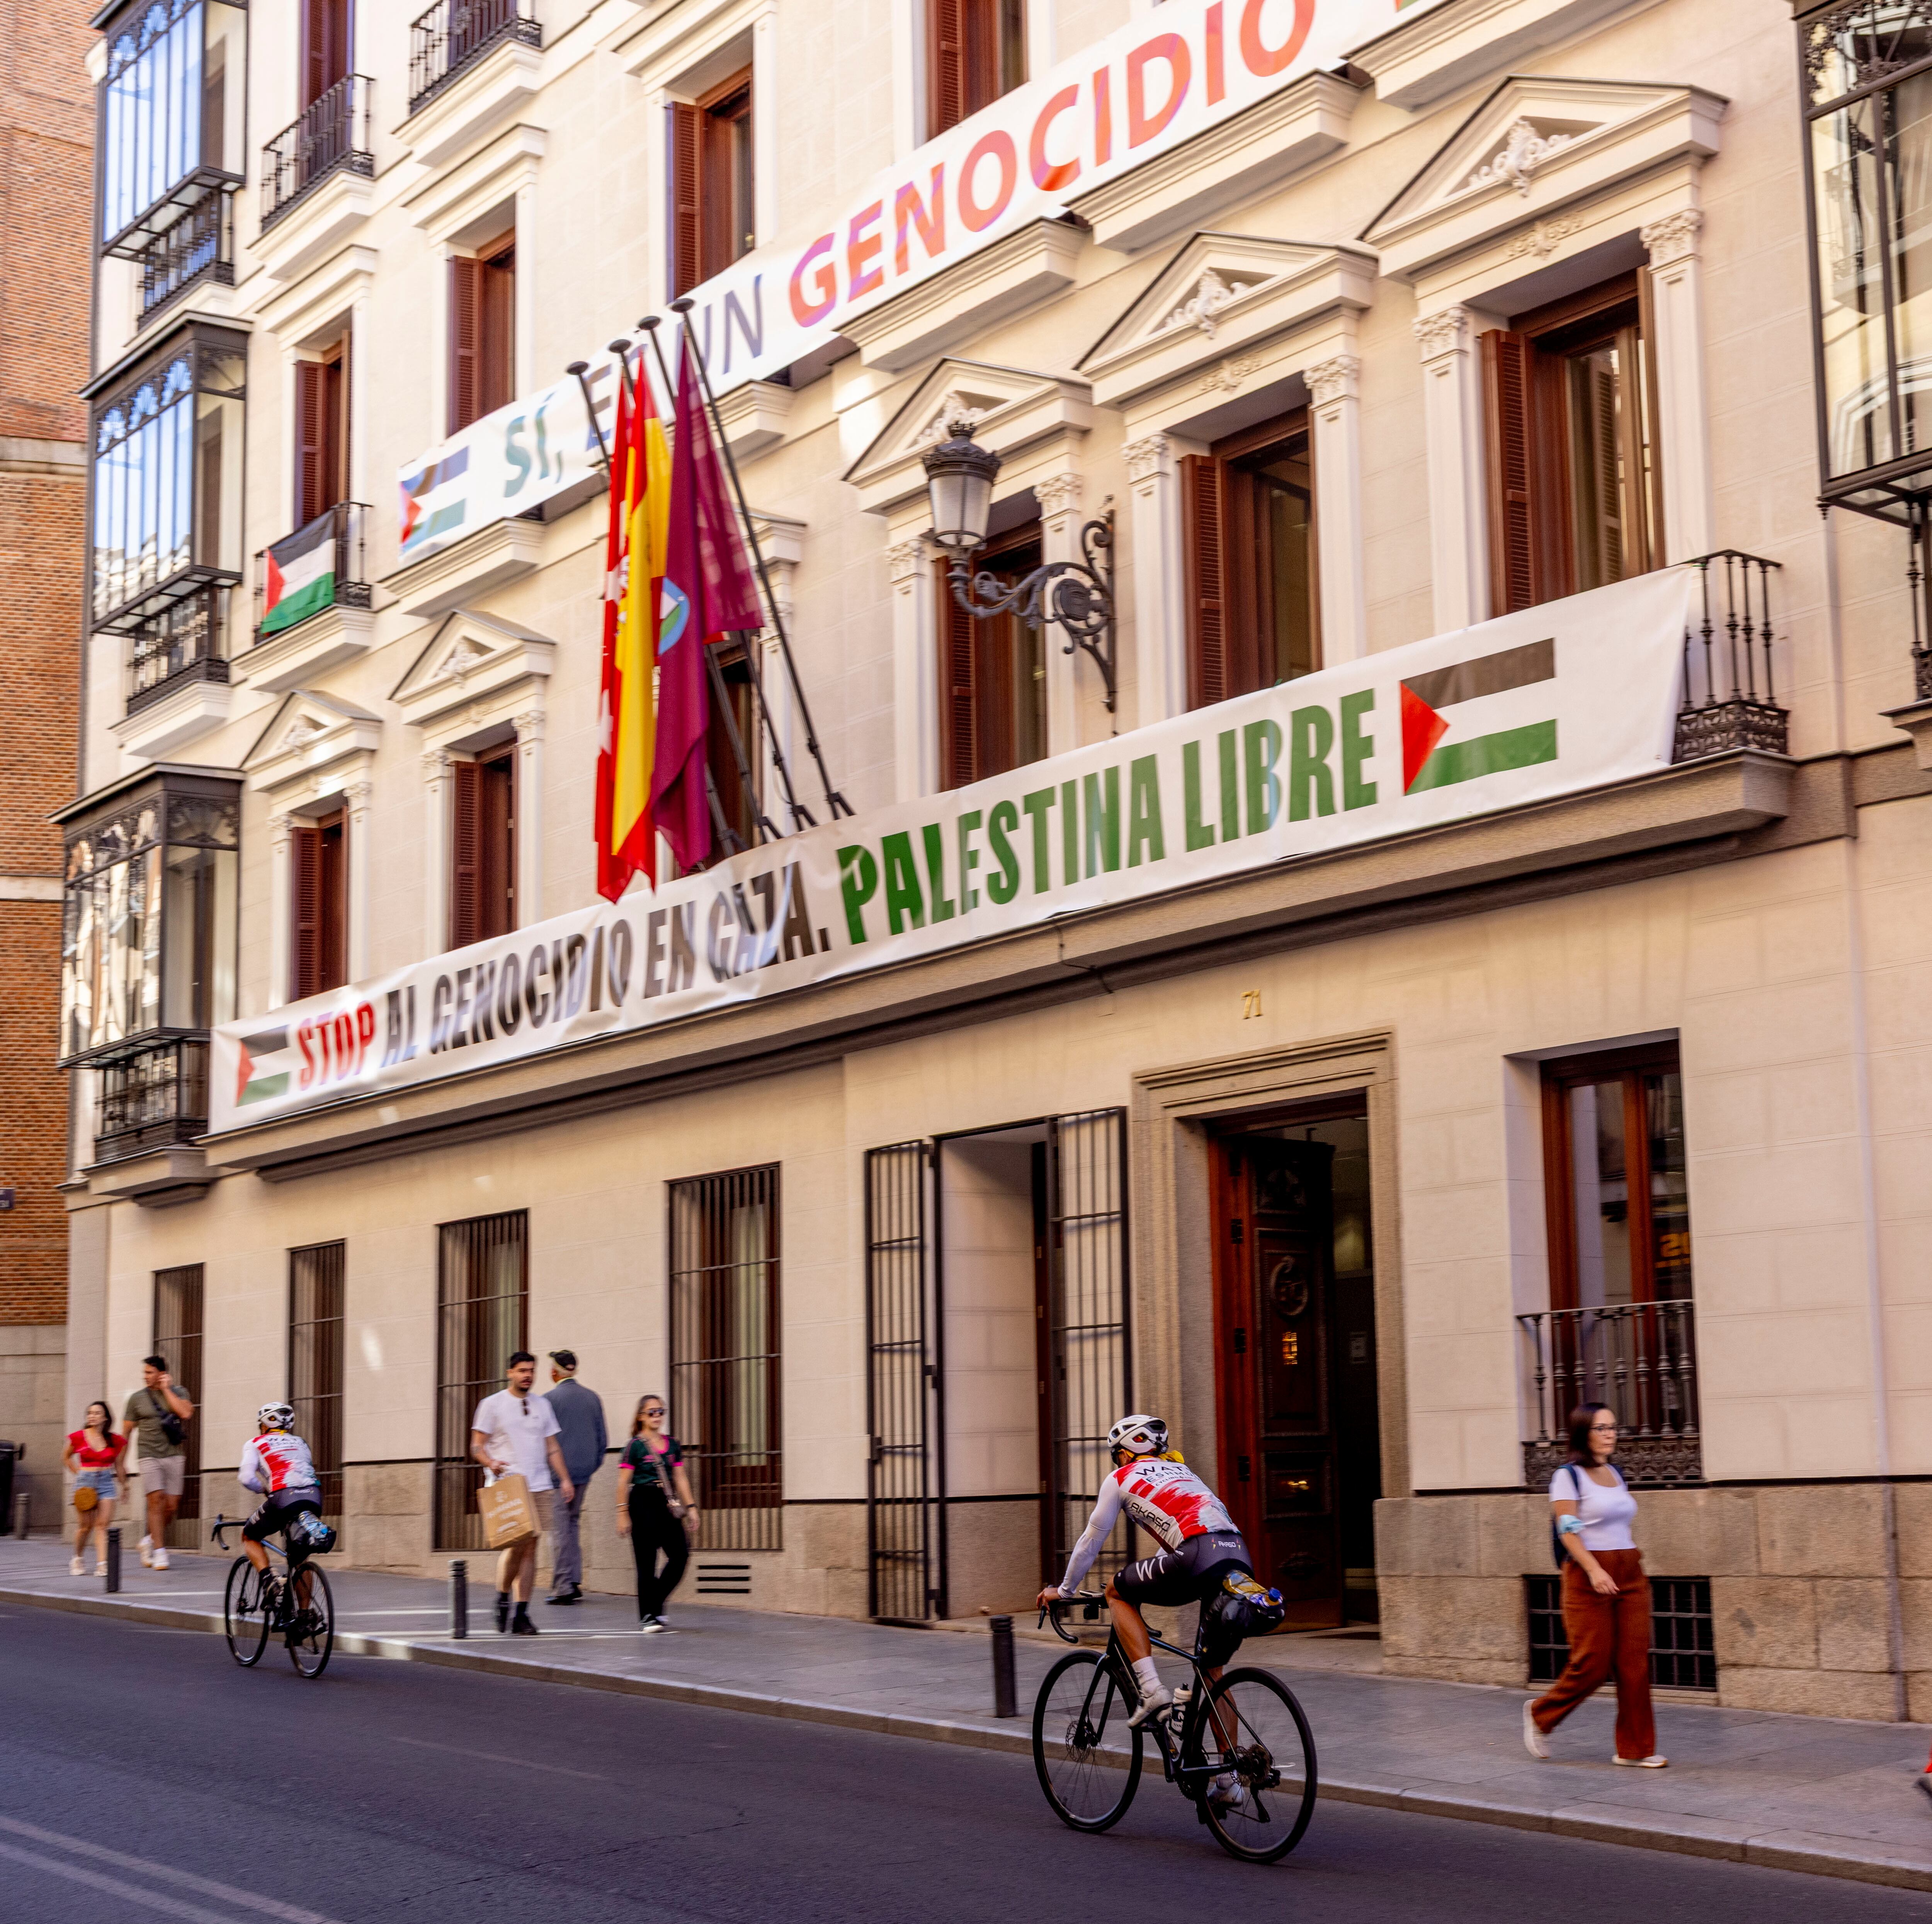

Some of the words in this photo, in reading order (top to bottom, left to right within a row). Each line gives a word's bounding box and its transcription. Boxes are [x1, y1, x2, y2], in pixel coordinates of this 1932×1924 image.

[503, 391, 564, 498] SÍ,
[675, 273, 762, 384] UN
[789, 0, 1315, 328] GENOCIDIO
[298, 1001, 375, 1090] STOP
[381, 984, 419, 1067] AL
[429, 919, 634, 1054] GENOCIDIO
[644, 900, 697, 999] EN
[706, 860, 831, 983] GAZA.
[836, 754, 1165, 945] PALESTINA
[1182, 688, 1377, 852] LIBRE
[1240, 989, 1261, 1019] 71
[1135, 1466, 1190, 1476] WAT
[1131, 1502, 1171, 1532] AKASO
[1136, 1554, 1168, 1581] WT
